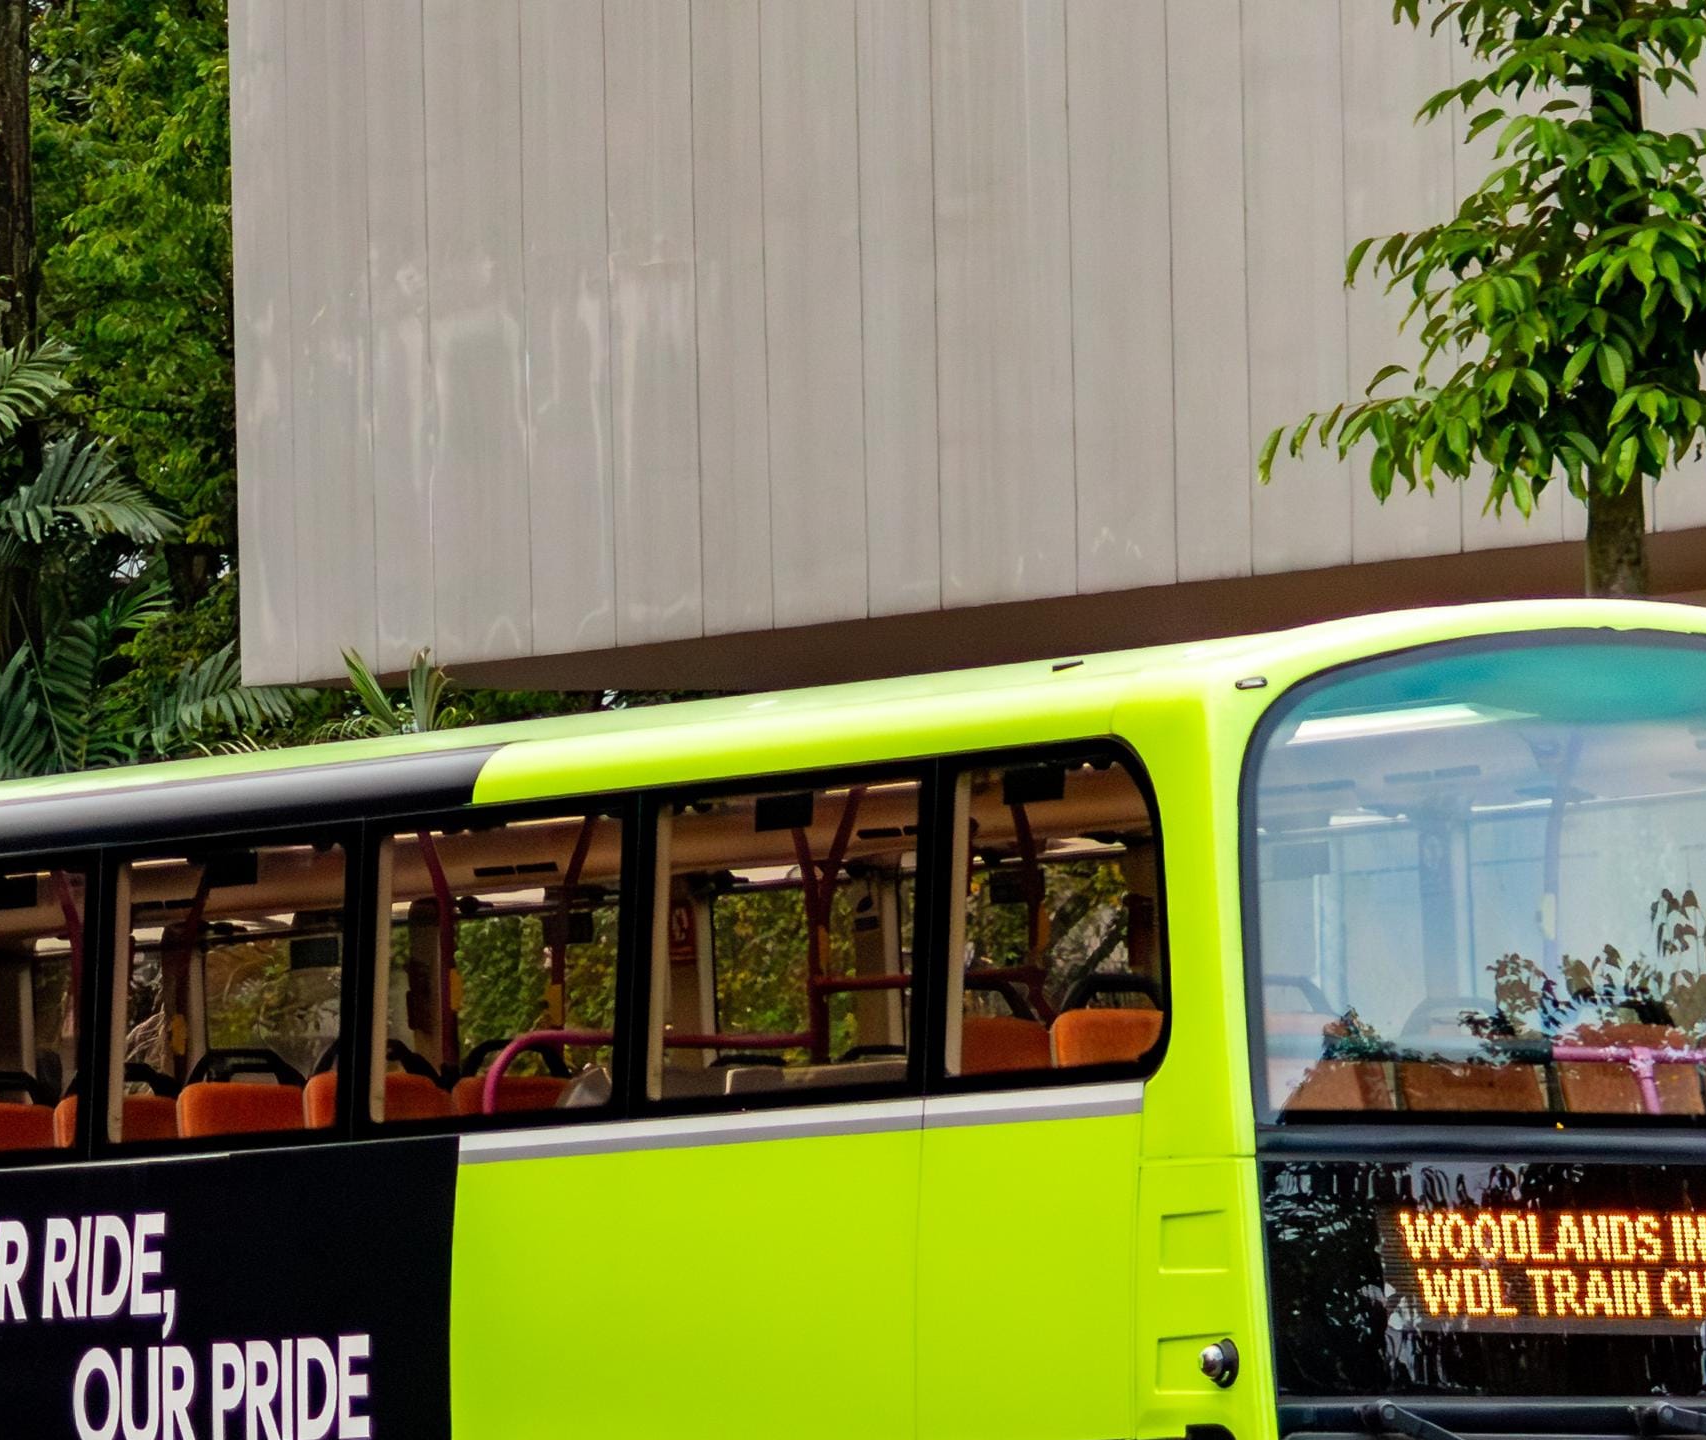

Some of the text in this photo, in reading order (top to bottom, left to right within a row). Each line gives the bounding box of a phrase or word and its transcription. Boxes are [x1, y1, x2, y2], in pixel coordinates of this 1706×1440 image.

[1399, 1211, 1664, 1263] WOODLANDS
[42, 1211, 176, 1339] RIDE,
[1415, 1267, 1518, 1318] WDL
[1527, 1267, 1652, 1318] TRAIN
